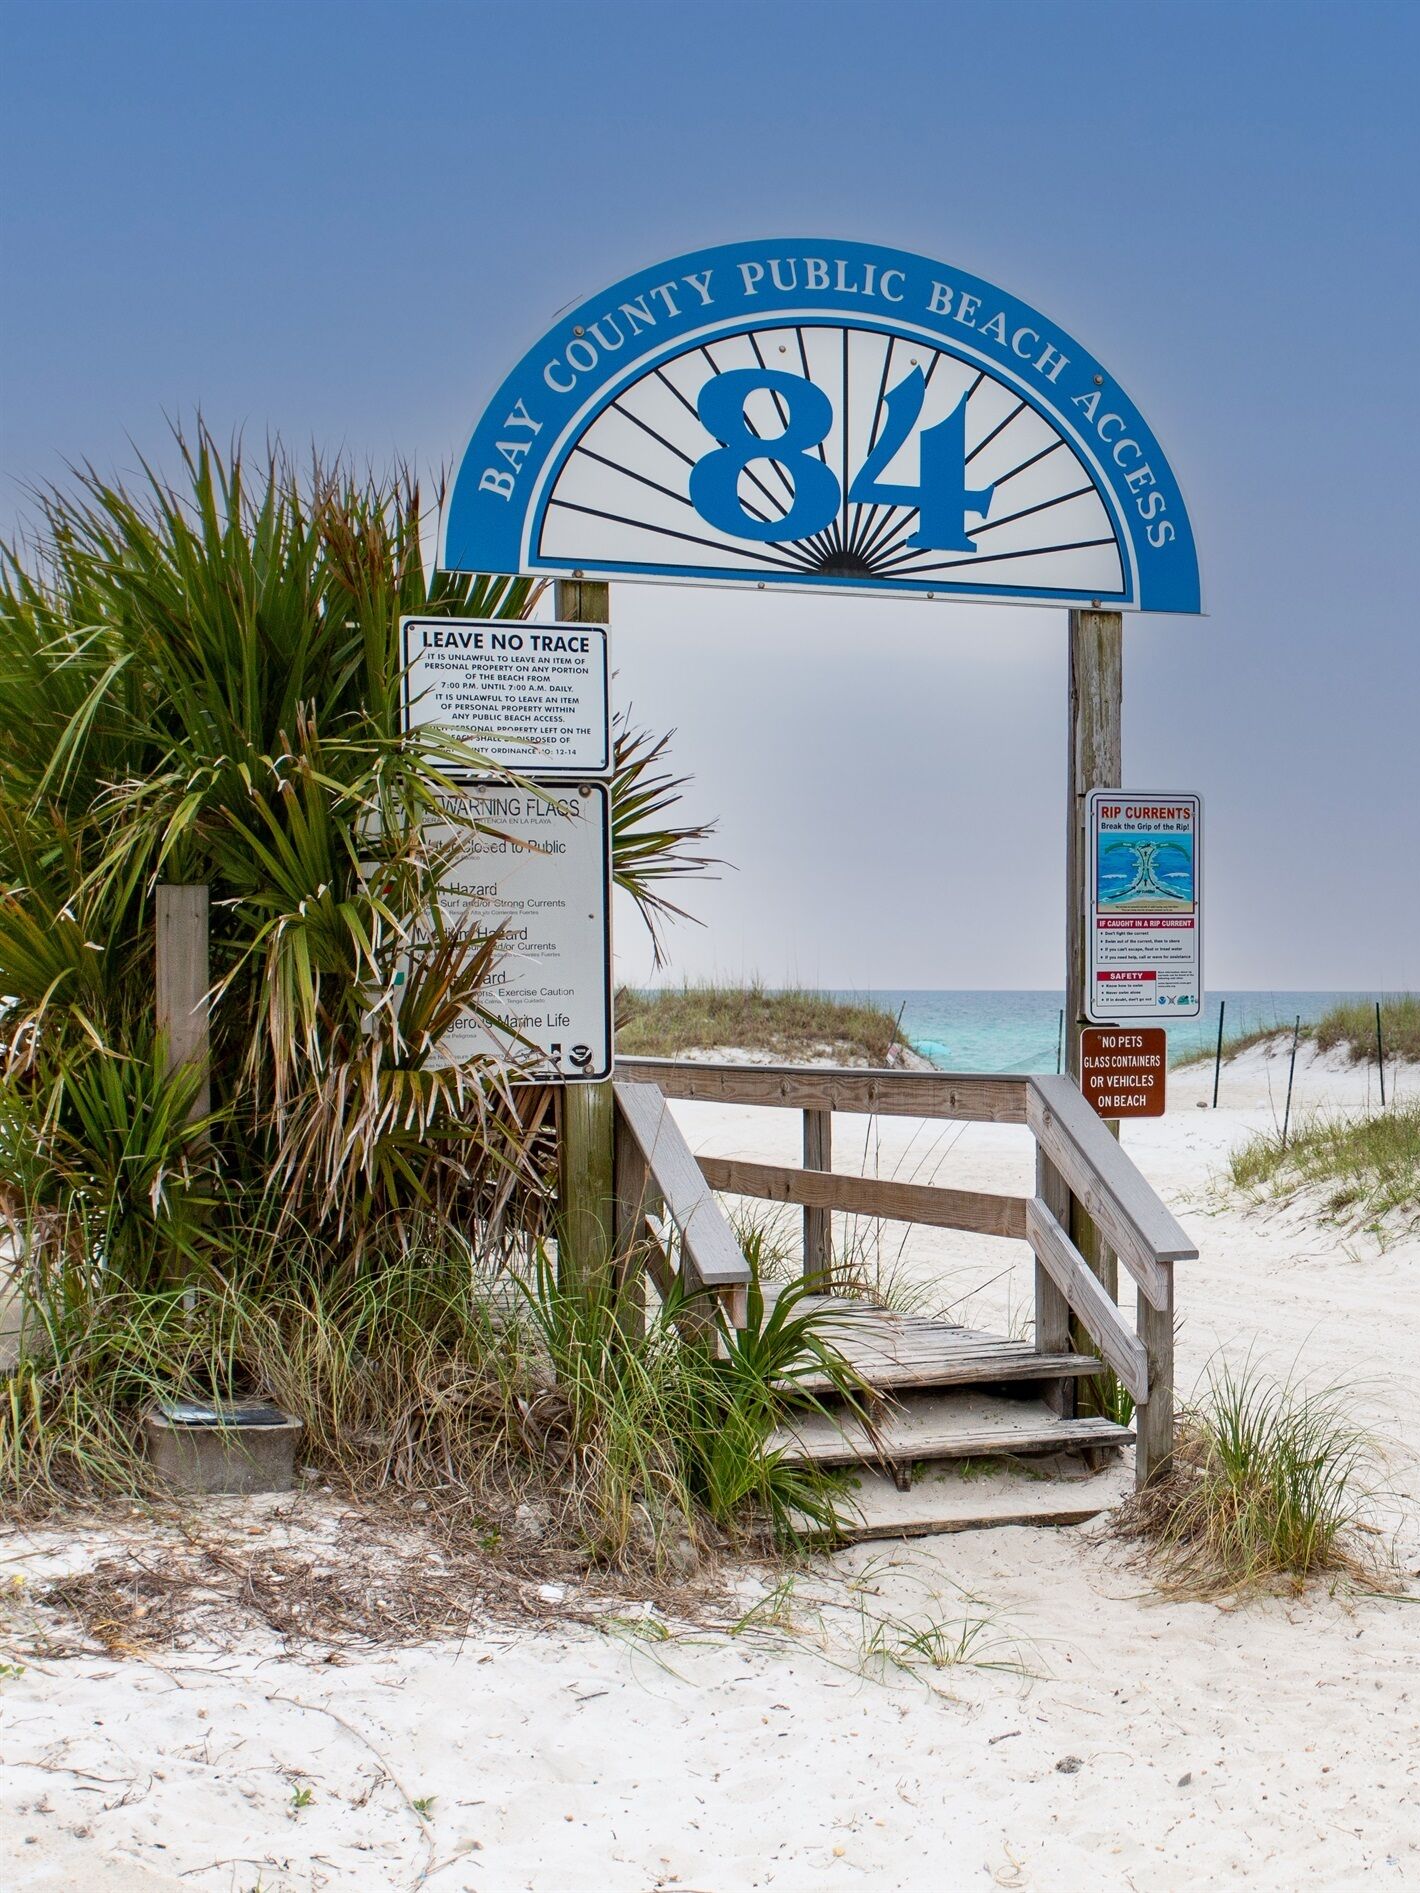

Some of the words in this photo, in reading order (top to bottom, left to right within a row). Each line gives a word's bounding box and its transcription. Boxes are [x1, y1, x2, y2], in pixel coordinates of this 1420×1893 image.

[479, 398, 543, 501] BAY
[544, 270, 714, 392] COUNTY
[737, 258, 906, 302] PUBLIC
[926, 280, 1071, 384] BEACH
[1071, 391, 1175, 547] ACCESS
[689, 364, 995, 552] 84
[423, 631, 483, 648] LEAVE
[492, 634, 523, 650] NO
[530, 635, 589, 652] TRACE
[456, 694, 502, 702] UNLAWFUL
[441, 797, 521, 816] WARNING
[1101, 806, 1122, 819] RIP
[1125, 806, 1191, 819] CURRENTS
[1101, 822, 1122, 830] Break
[1137, 823, 1152, 832] Grip
[1176, 823, 1190, 832] Rip!
[528, 840, 567, 854] Public
[450, 882, 497, 896] Hazard
[441, 900, 459, 908] Surf
[494, 899, 525, 909] Strong
[527, 899, 566, 908] Currents
[517, 942, 557, 951] Currents
[1110, 972, 1144, 980] SAFETY
[498, 988, 538, 997] Exercise
[540, 988, 575, 996] Caution
[497, 1014, 542, 1028] Marine
[547, 1013, 571, 1028] Life
[1102, 1036, 1116, 1048] NO
[1118, 1035, 1143, 1048] PETS
[1083, 1056, 1110, 1068] GLASS
[1111, 1055, 1161, 1068] CONTAINERS
[1090, 1076, 1104, 1088] OR
[1106, 1074, 1154, 1087] VEHICLES
[1097, 1095, 1112, 1107] ON
[1113, 1094, 1147, 1107] BEACH
